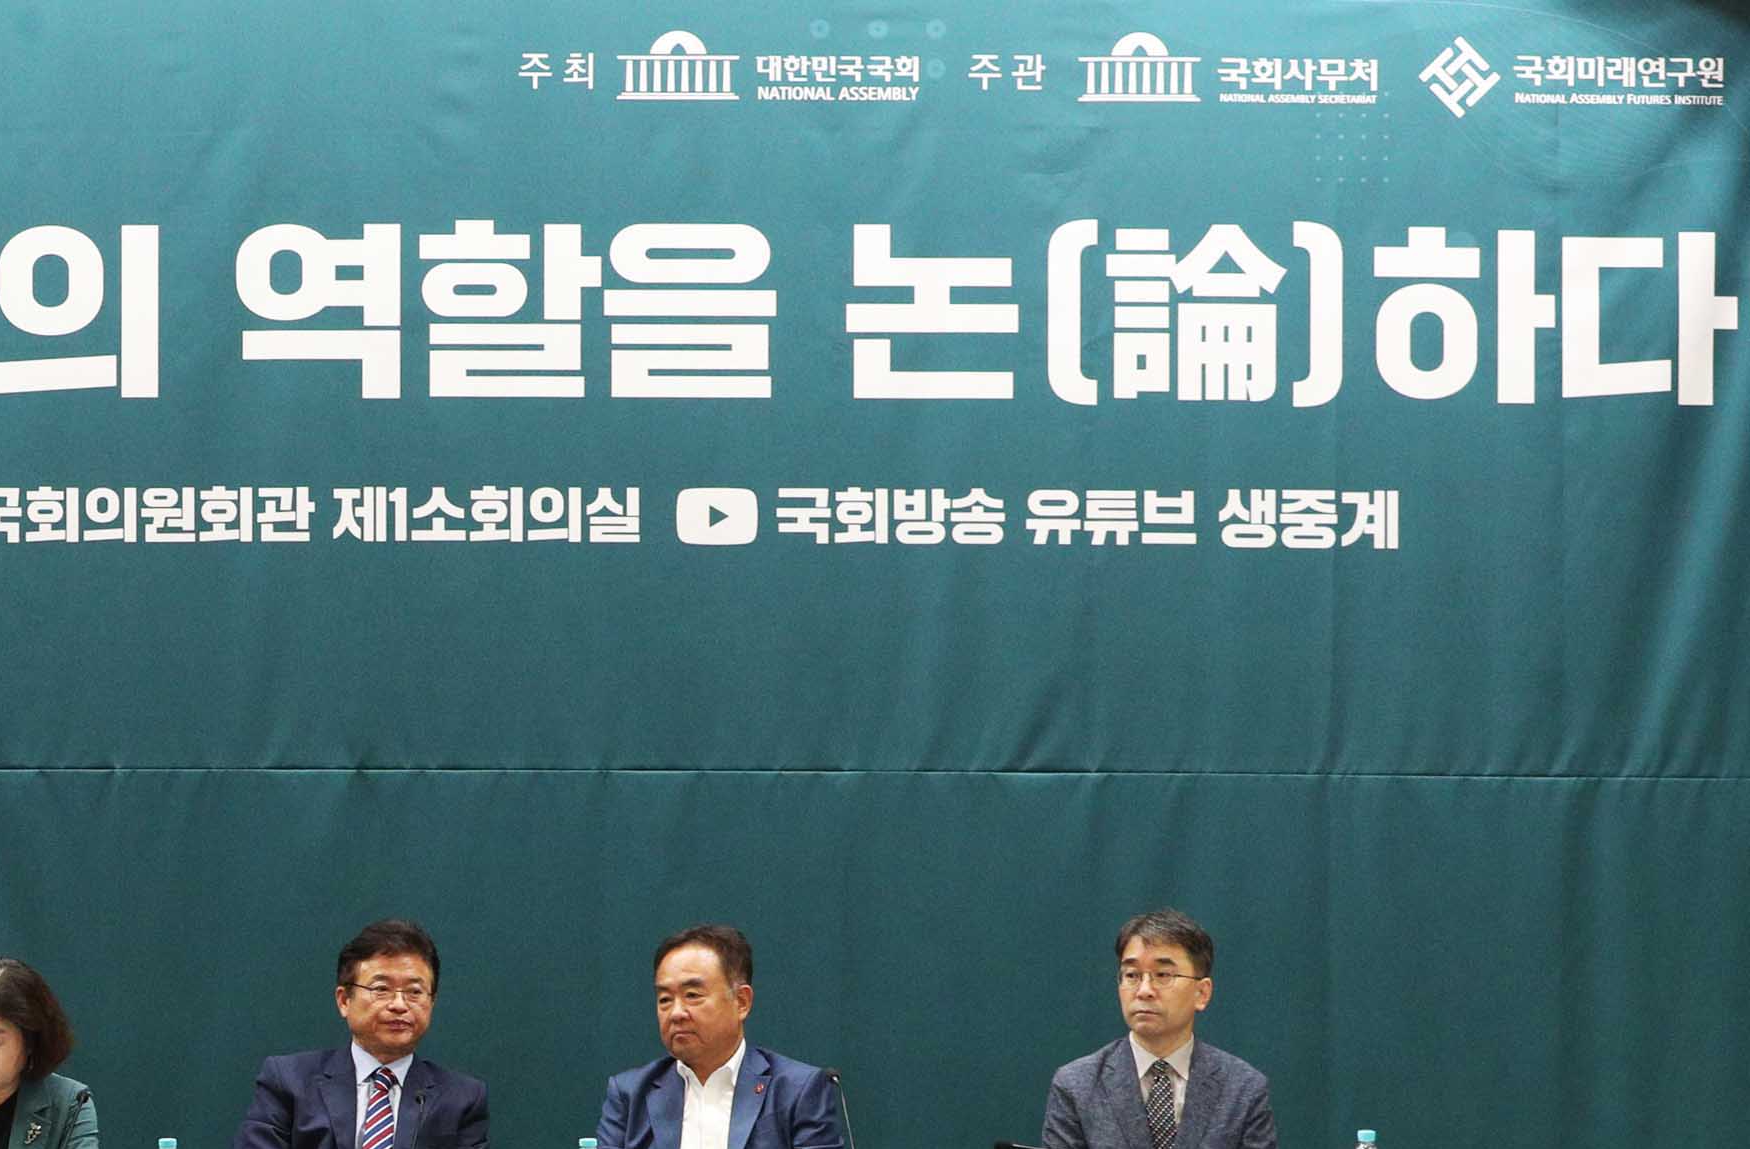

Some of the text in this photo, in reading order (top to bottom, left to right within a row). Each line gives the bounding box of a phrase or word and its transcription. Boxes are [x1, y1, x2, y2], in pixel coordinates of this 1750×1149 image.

[756, 55, 920, 83] 대한민국국회
[1217, 57, 1379, 92] 국회사무처
[1513, 55, 1725, 89] 국회미래연구원
[757, 86, 920, 101] NATIONAL ASSEMBLY
[1219, 93, 1378, 105] NATIONAL ASSEMBLY SECRETARIAT
[1514, 92, 1723, 106] NATIONAL ASSEMBLY FUTURES INSTITUTE
[235, 219, 778, 399] 역할을
[845, 218, 1739, 408] 논(論)하다
[332, 486, 641, 543] 제1소회의실
[776, 487, 1399, 550] 국회방송 유튜브 생중계
